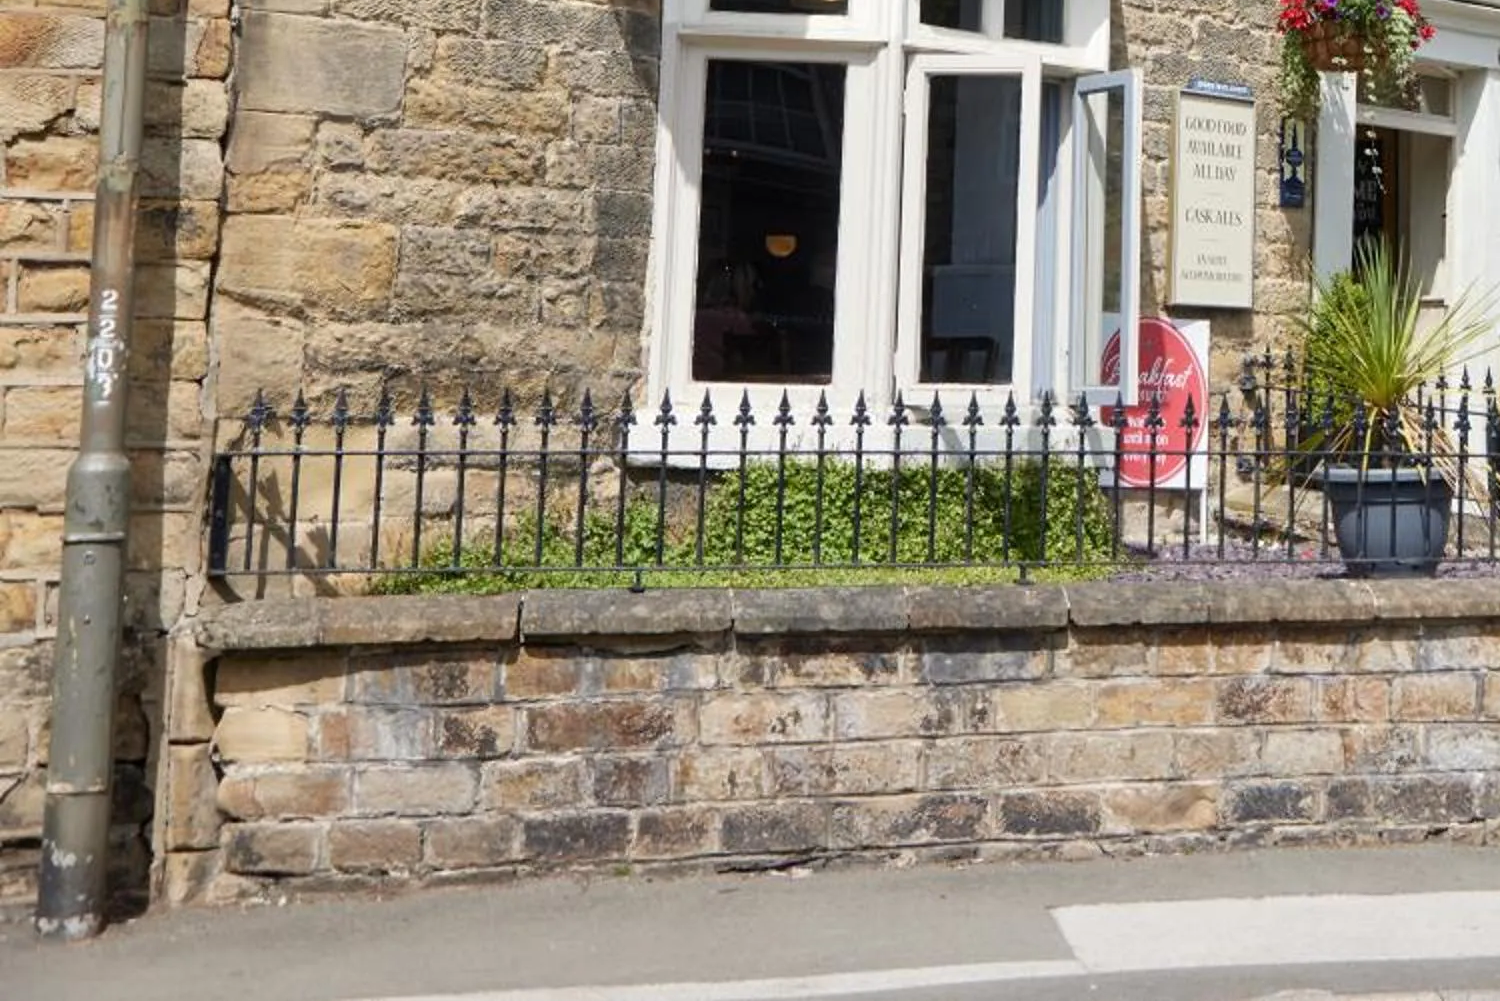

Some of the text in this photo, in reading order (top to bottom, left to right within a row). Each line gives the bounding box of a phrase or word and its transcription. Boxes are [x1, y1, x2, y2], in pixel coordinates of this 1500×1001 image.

[1185, 116, 1247, 137] GOOD FOOD
[1188, 139, 1243, 160] AVAILABLE
[1193, 163, 1237, 182] ALL DAY
[1185, 206, 1243, 226] CASK ALES
